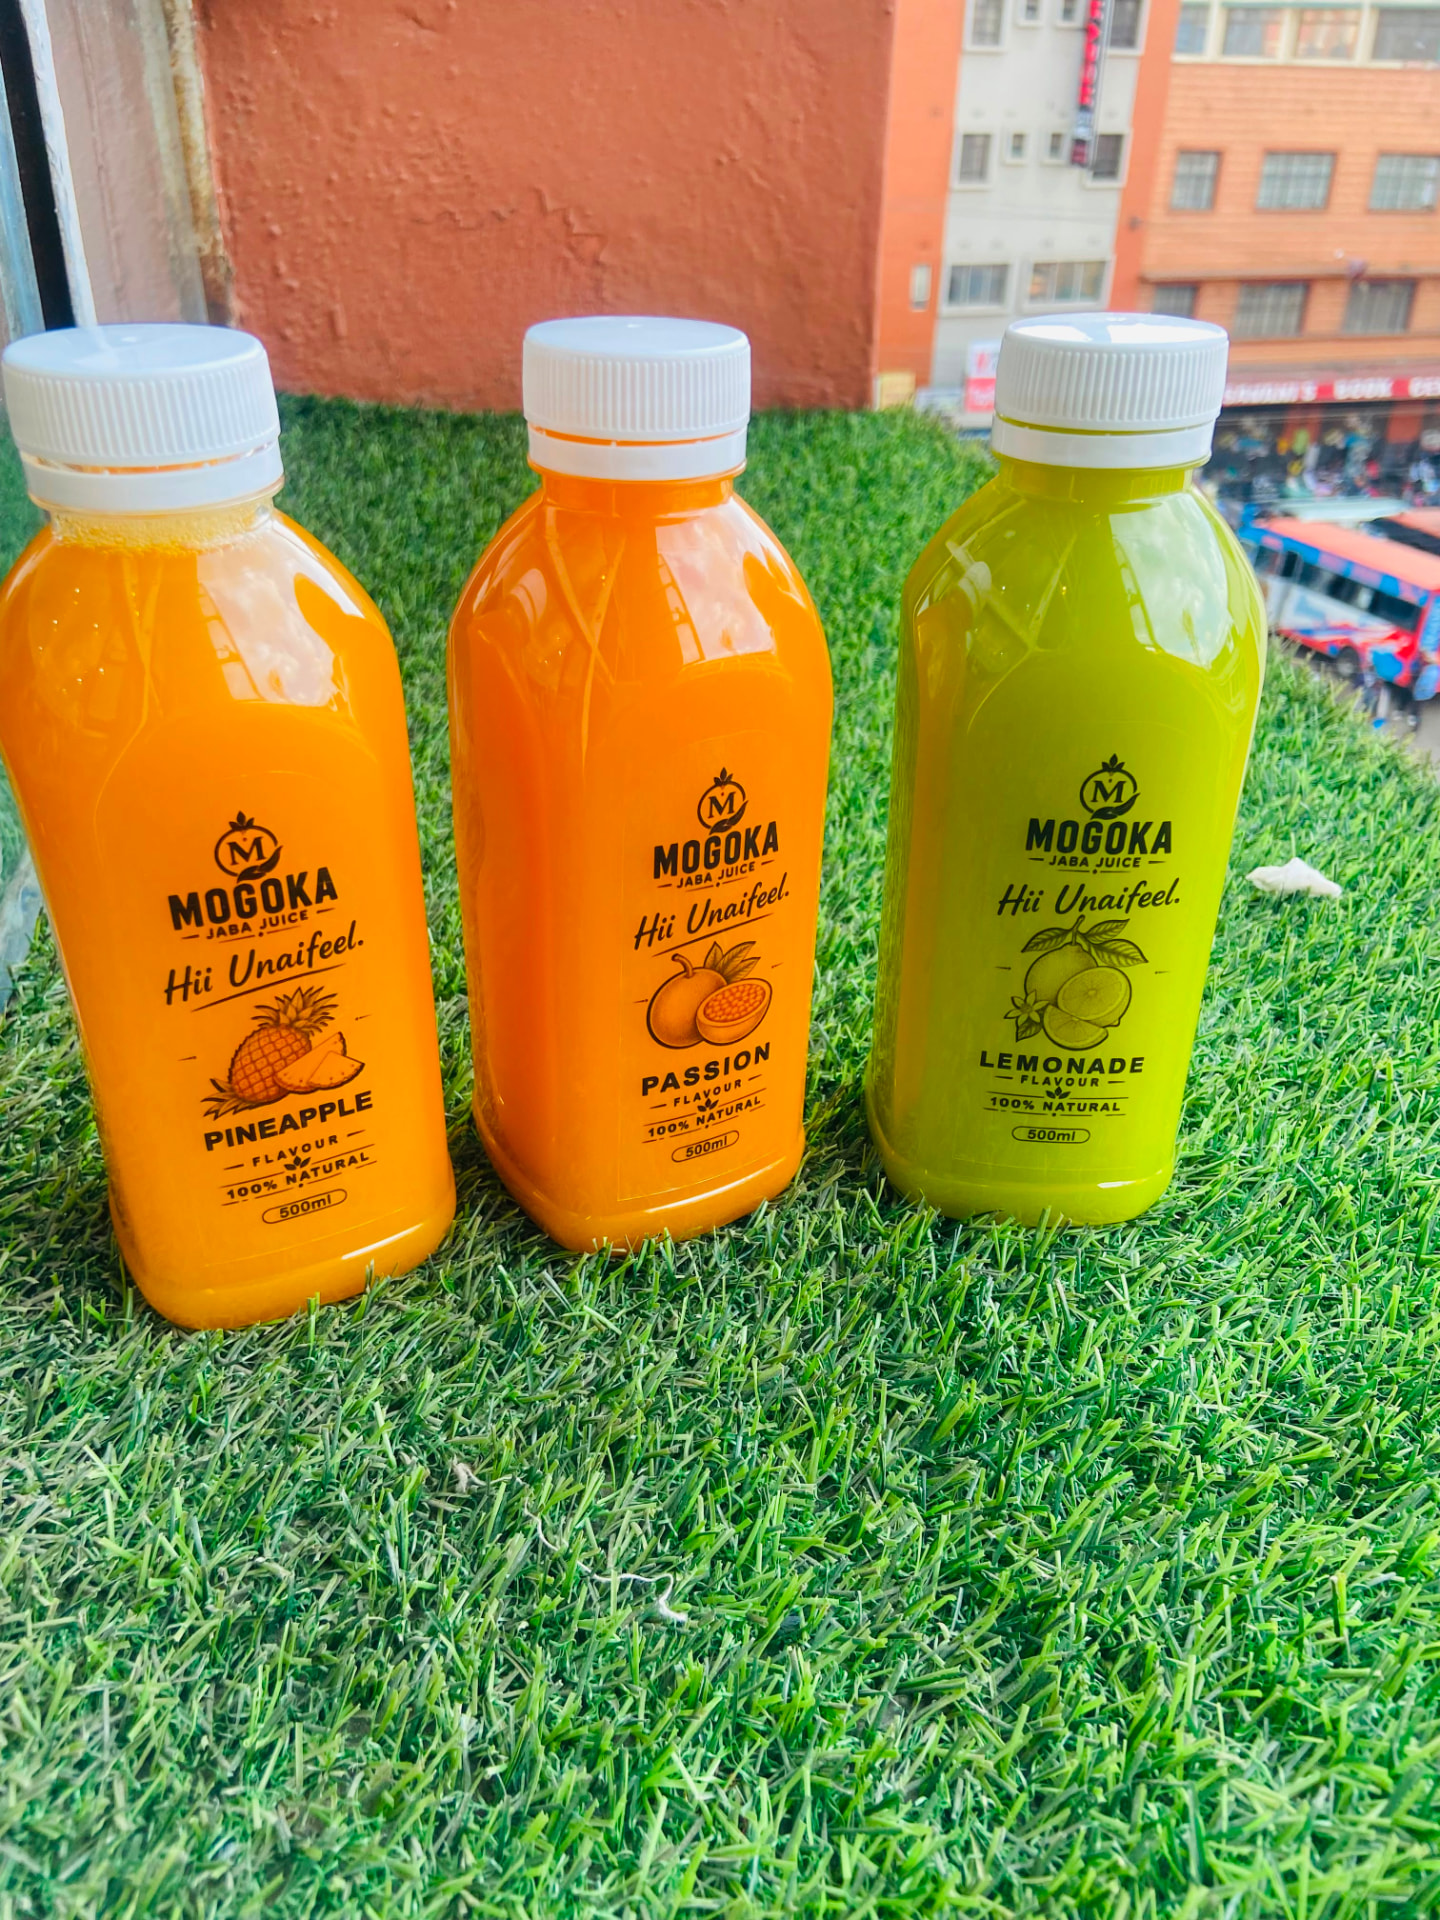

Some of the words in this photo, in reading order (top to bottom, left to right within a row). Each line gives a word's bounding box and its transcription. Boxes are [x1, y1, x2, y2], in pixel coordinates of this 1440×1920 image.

[707, 791, 736, 819] M
[1090, 780, 1127, 803] M
[226, 836, 267, 866] M
[653, 821, 779, 879] MOGOKA
[1025, 818, 1172, 855] MOGOKA
[676, 872, 713, 888] JABA
[718, 861, 756, 880] JUICE
[1048, 855, 1089, 868] JABA
[1095, 857, 1141, 868] JUICE
[167, 866, 338, 931] MOGOKA
[634, 912, 676, 950] Hii
[686, 872, 790, 934] Unaifeel.
[997, 884, 1044, 916] Hii
[1054, 877, 1180, 915] Unaifeel.
[206, 922, 253, 940] JABA
[259, 909, 309, 930] JUICE
[164, 965, 213, 1005] Hii
[229, 919, 364, 987] Unaifeel.
[641, 1042, 770, 1096] PASSION
[979, 1051, 1145, 1074] LEMONADE
[673, 1079, 742, 1107] FLAVOUR
[1020, 1075, 1100, 1087] FLAVOUR
[648, 1120, 689, 1137] 100%
[696, 1096, 761, 1126] NATURAL
[990, 1097, 1035, 1110] 100%
[1043, 1102, 1121, 1112] NATURAL
[203, 1090, 373, 1152] PINEAPPLE
[1027, 1129, 1076, 1142] 500ml
[252, 1135, 338, 1167] FLAVOUR
[685, 1135, 728, 1158] 500ml
[226, 1179, 278, 1200] 100%
[285, 1152, 370, 1185] NATURAL
[279, 1194, 332, 1219] 500ml
